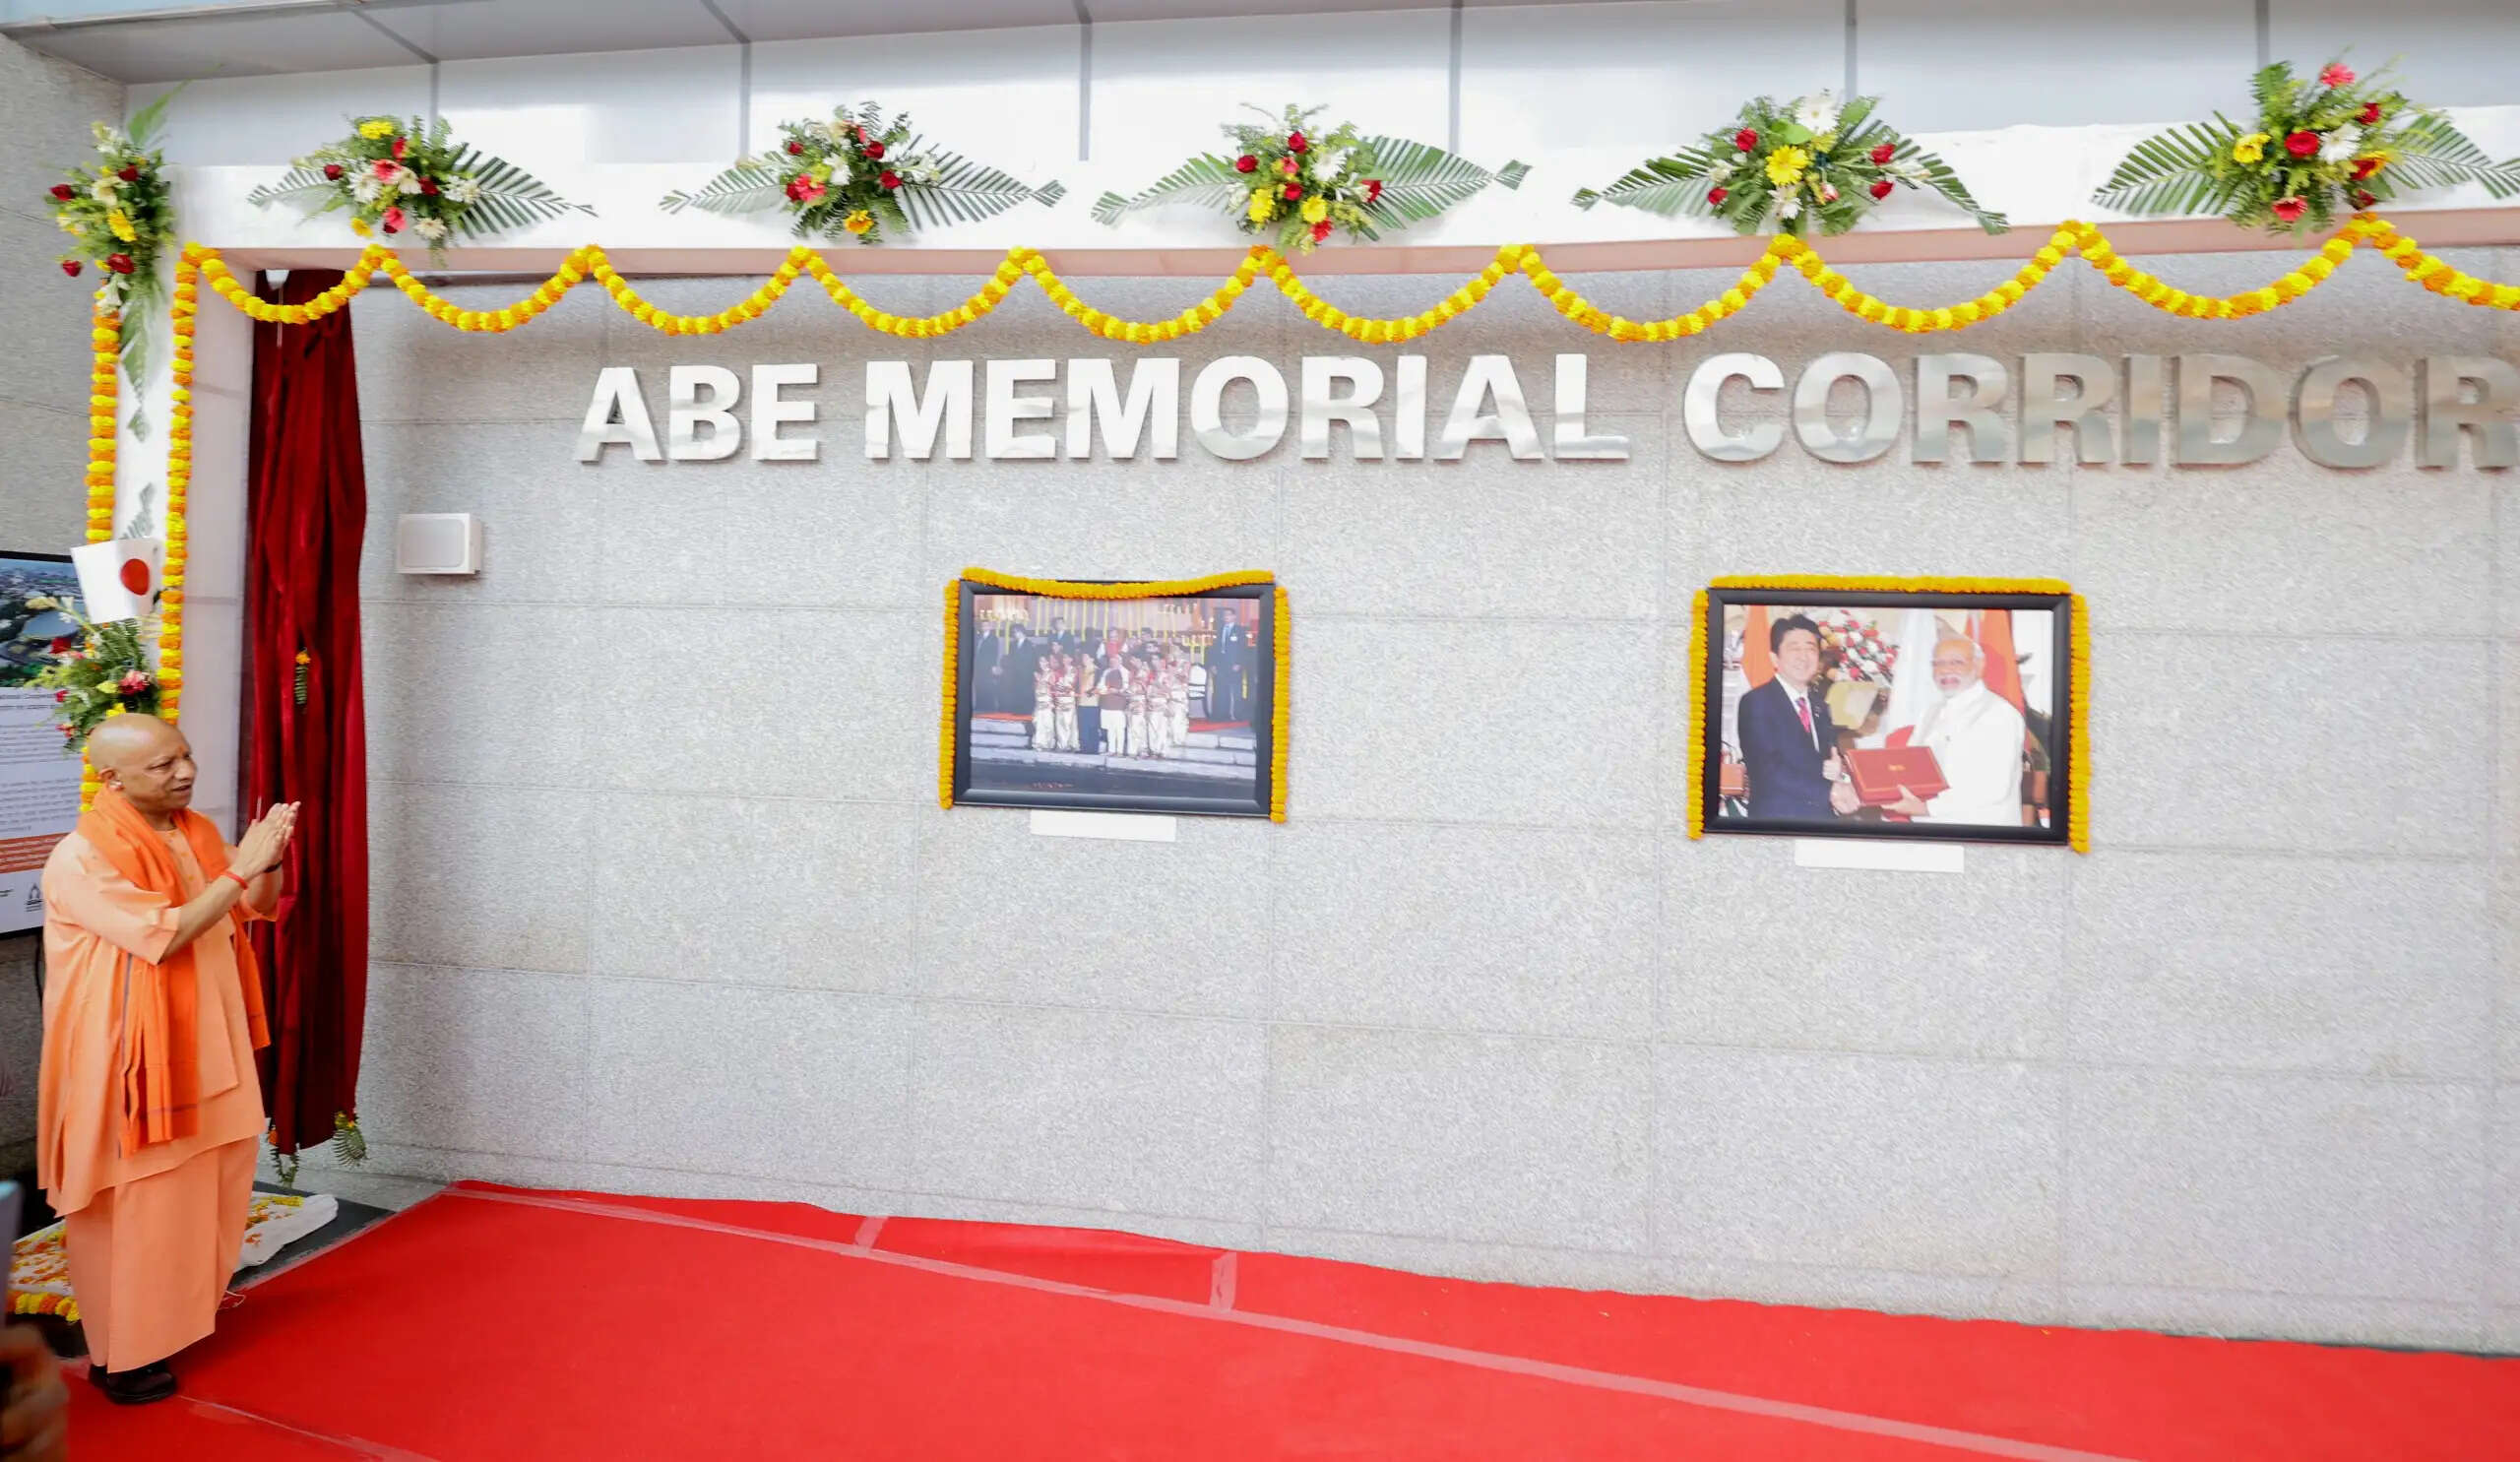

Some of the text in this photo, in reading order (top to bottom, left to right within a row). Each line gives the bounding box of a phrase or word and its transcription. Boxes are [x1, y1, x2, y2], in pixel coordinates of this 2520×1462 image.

[577, 351, 2520, 470] ABE MEMORIAL CORRIDOR
